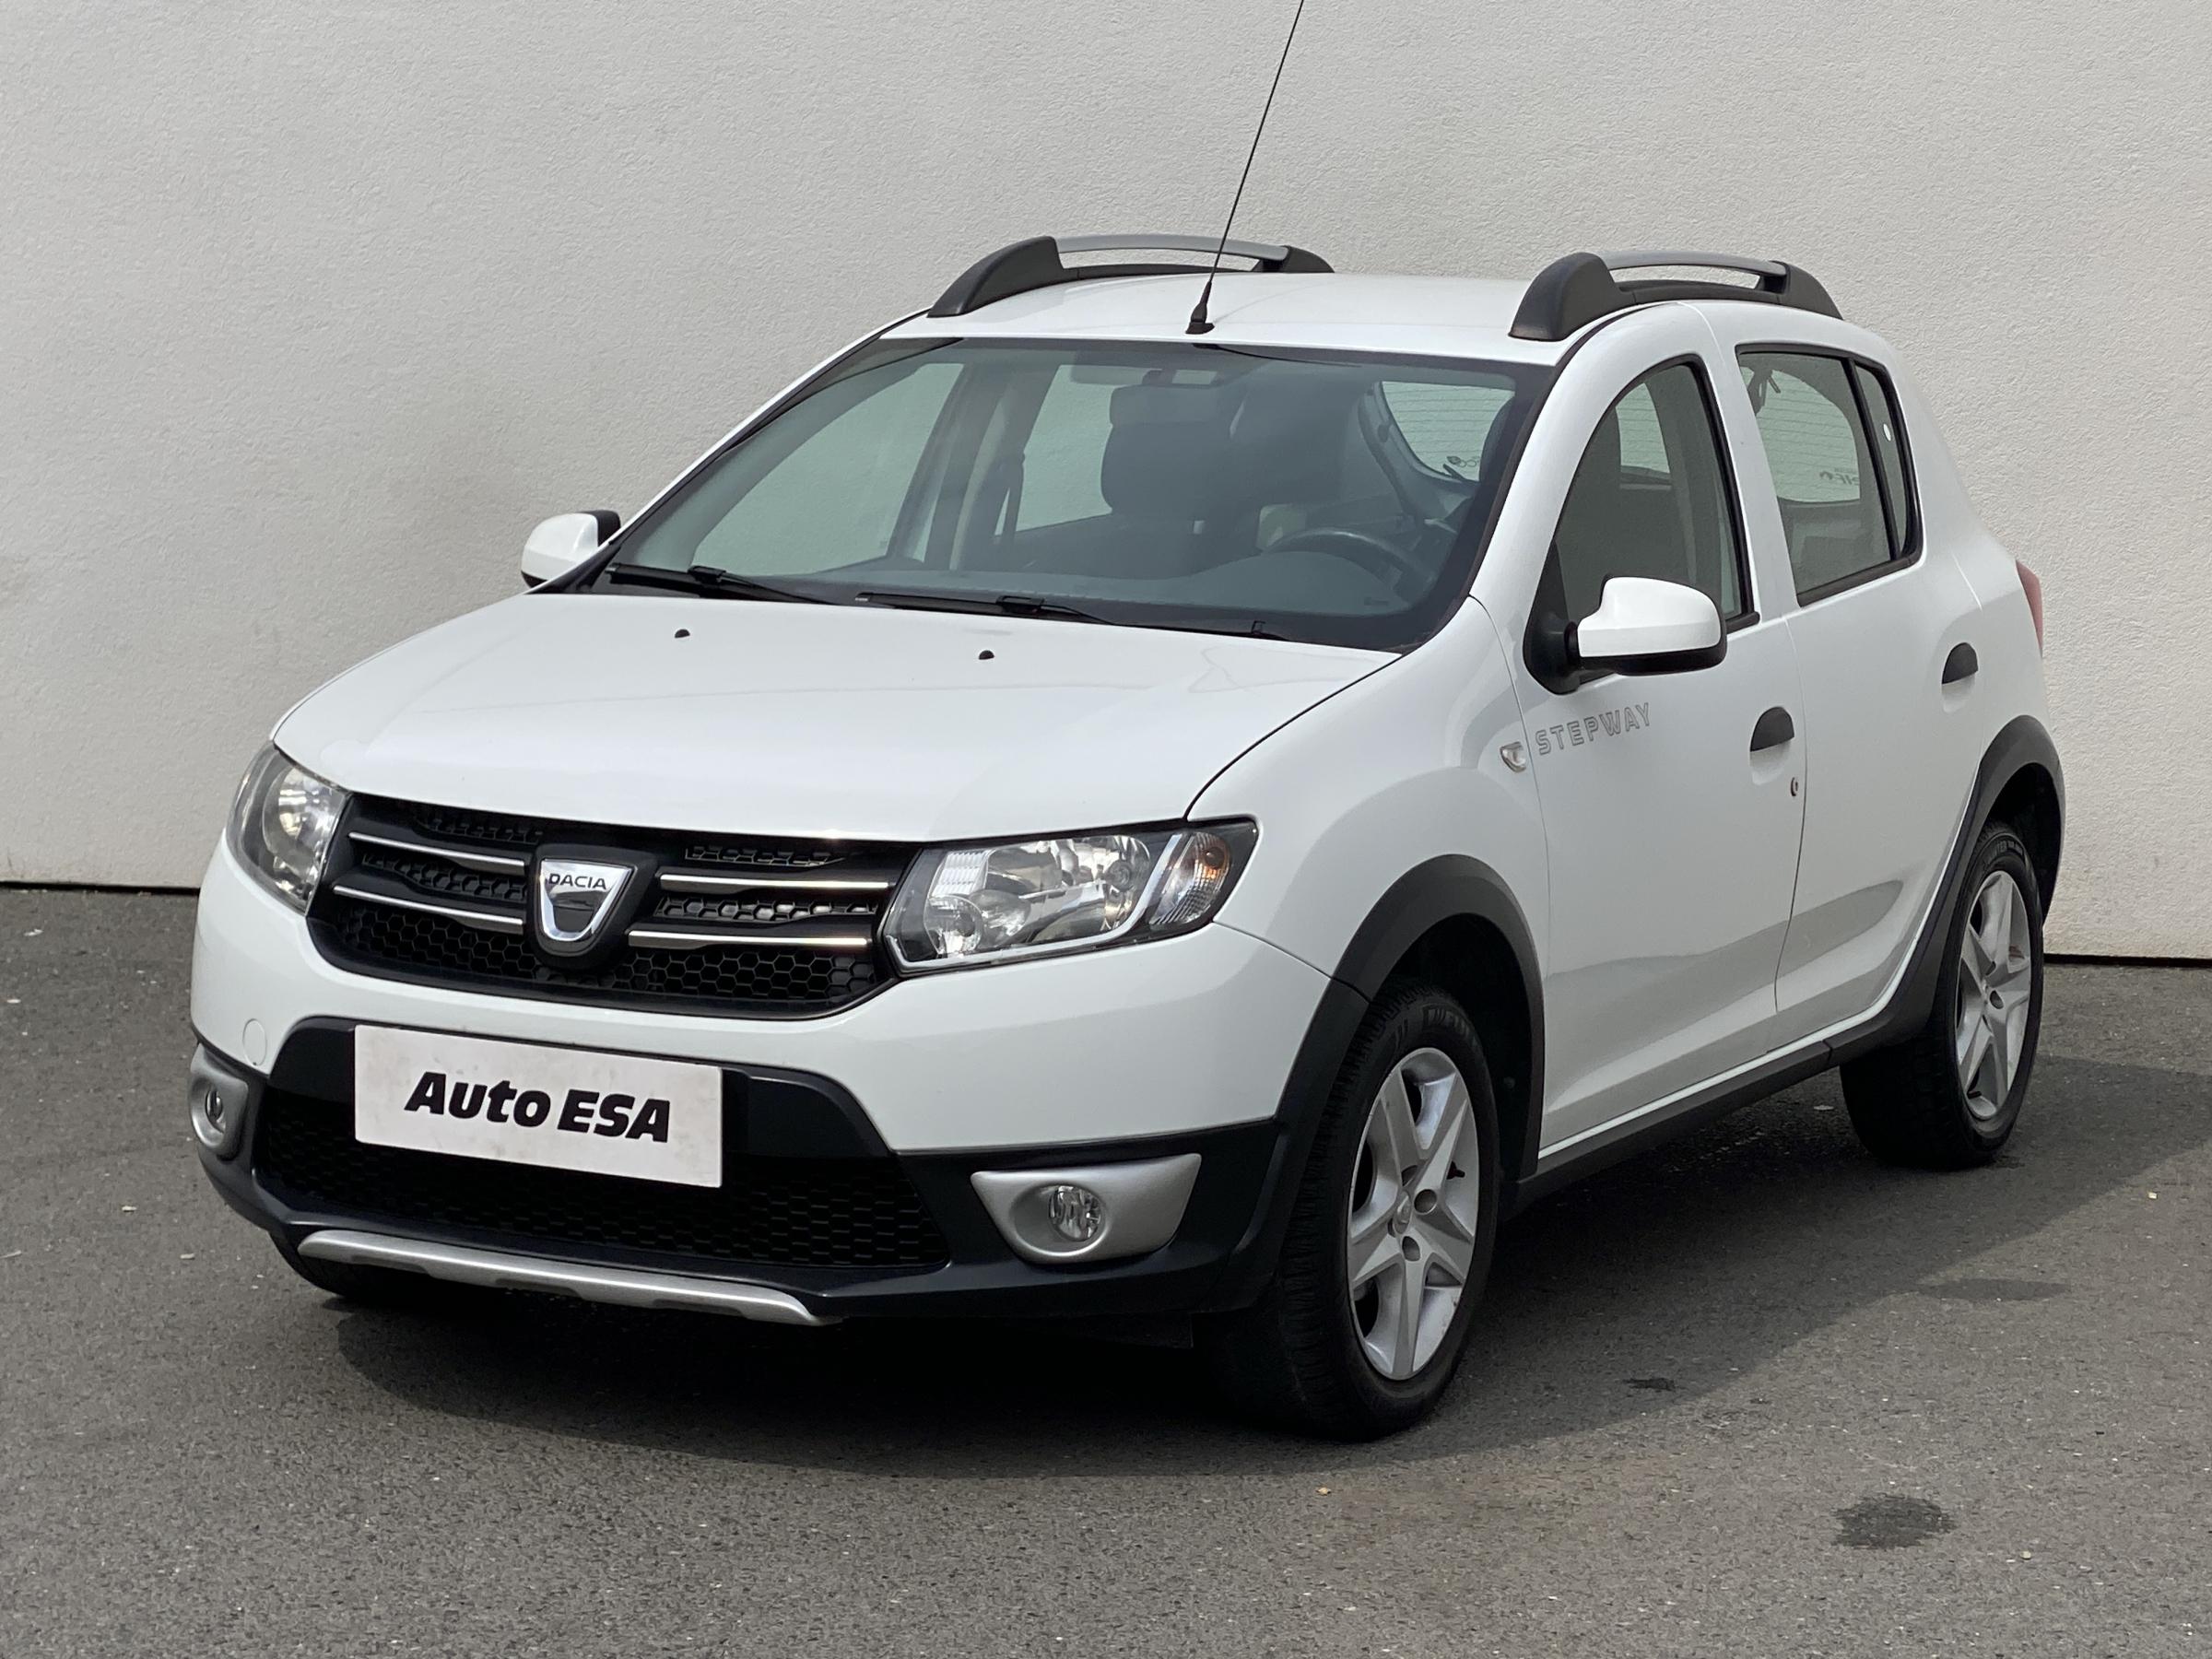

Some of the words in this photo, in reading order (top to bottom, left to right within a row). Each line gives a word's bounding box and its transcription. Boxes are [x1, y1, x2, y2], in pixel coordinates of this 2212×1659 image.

[1535, 702, 1650, 756] STEPWAY
[548, 873, 606, 889] DACIA
[405, 1071, 551, 1127] Auto
[557, 1088, 670, 1143] ESA
